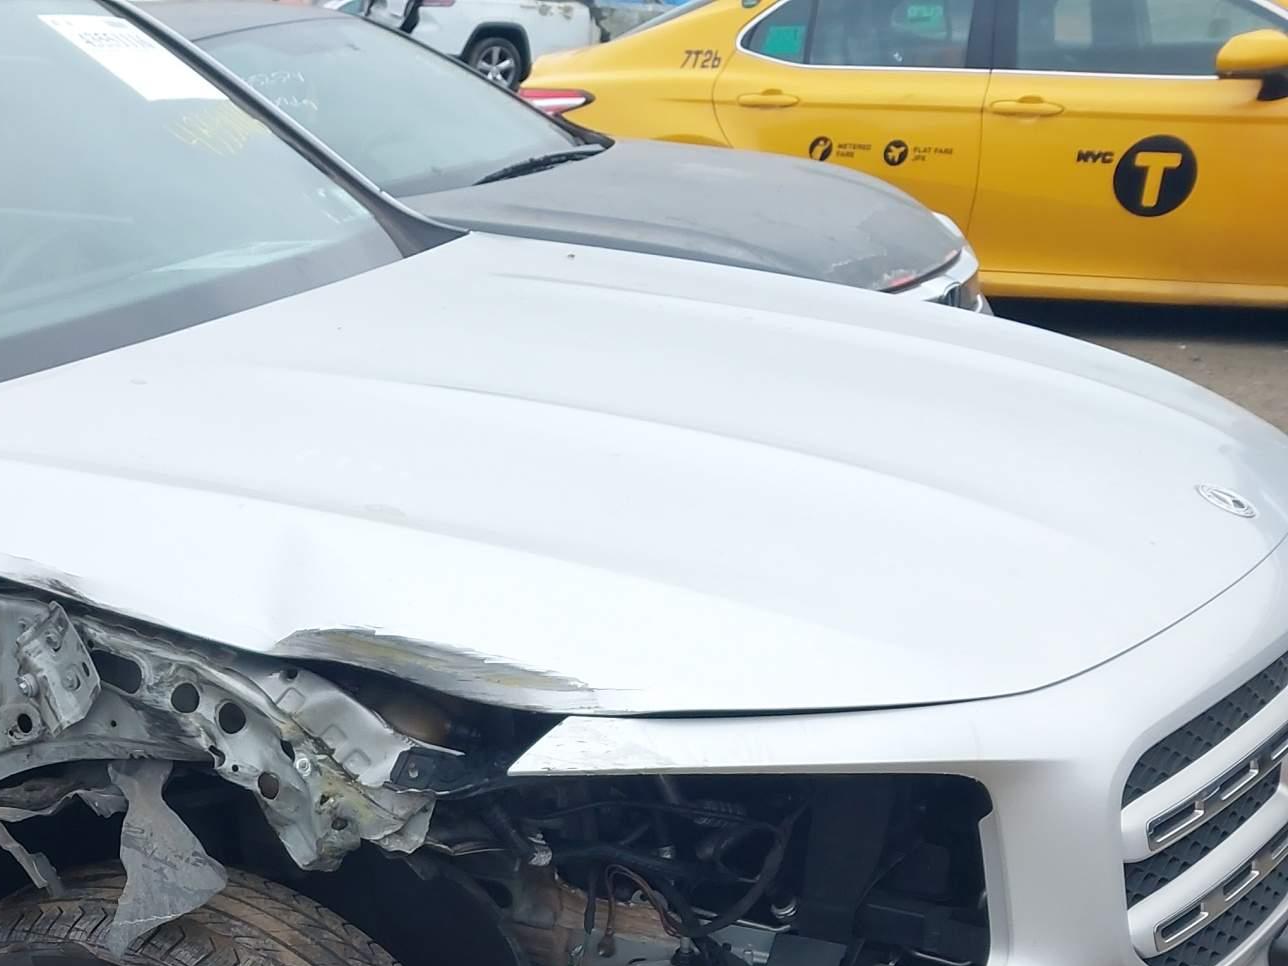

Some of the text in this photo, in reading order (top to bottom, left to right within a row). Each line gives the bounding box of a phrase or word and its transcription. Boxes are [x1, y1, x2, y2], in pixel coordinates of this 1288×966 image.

[913, 146, 953, 155] FLAT FARE
[1076, 150, 1114, 164] NYC
[1135, 151, 1182, 208] T
